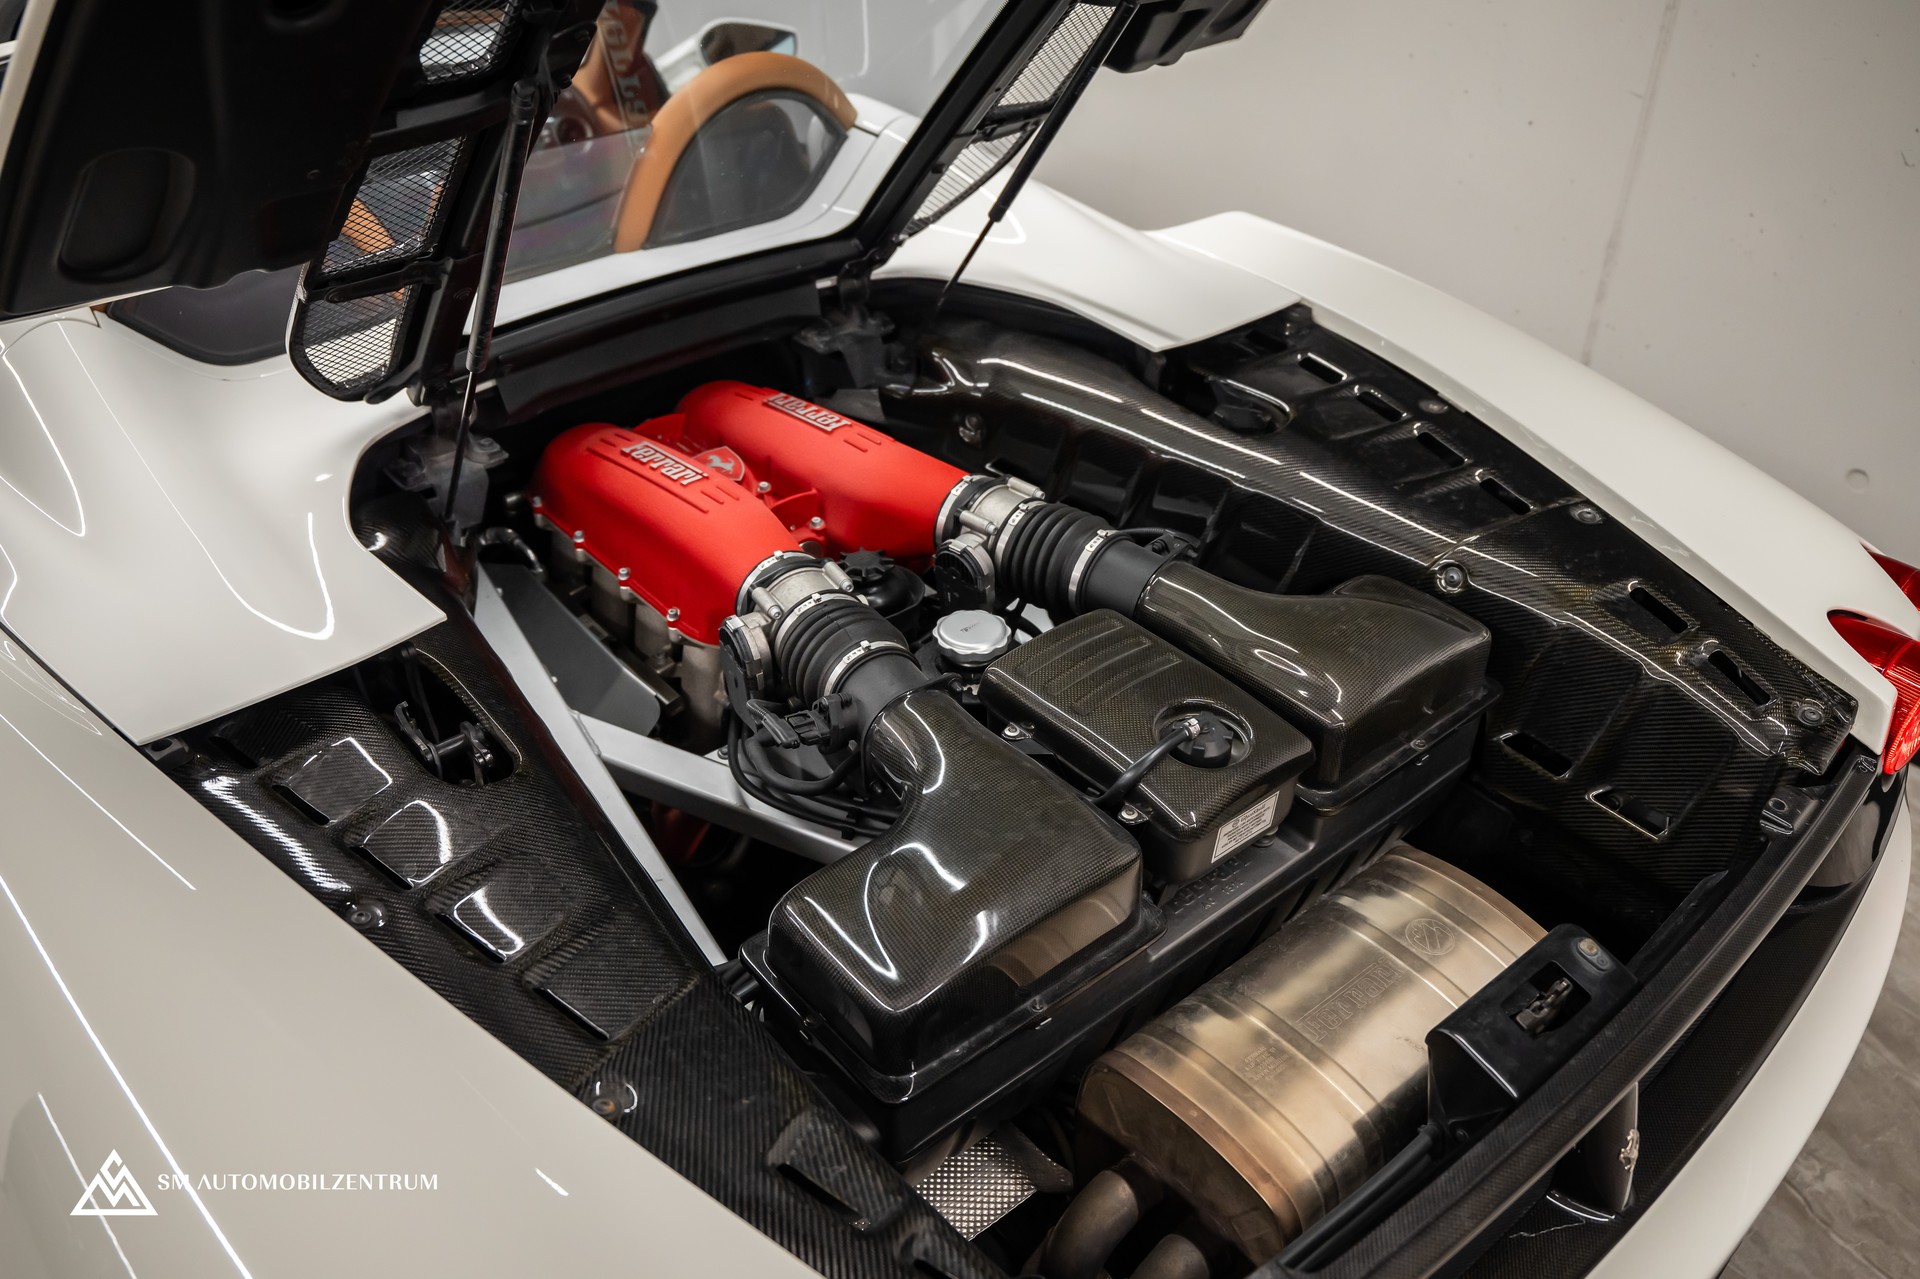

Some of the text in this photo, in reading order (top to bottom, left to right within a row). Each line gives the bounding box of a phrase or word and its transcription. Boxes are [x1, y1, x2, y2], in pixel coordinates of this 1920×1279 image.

[763, 393, 852, 431] Ferrari
[621, 441, 709, 485] Ferrari
[1296, 956, 1403, 1041] Ferrari
